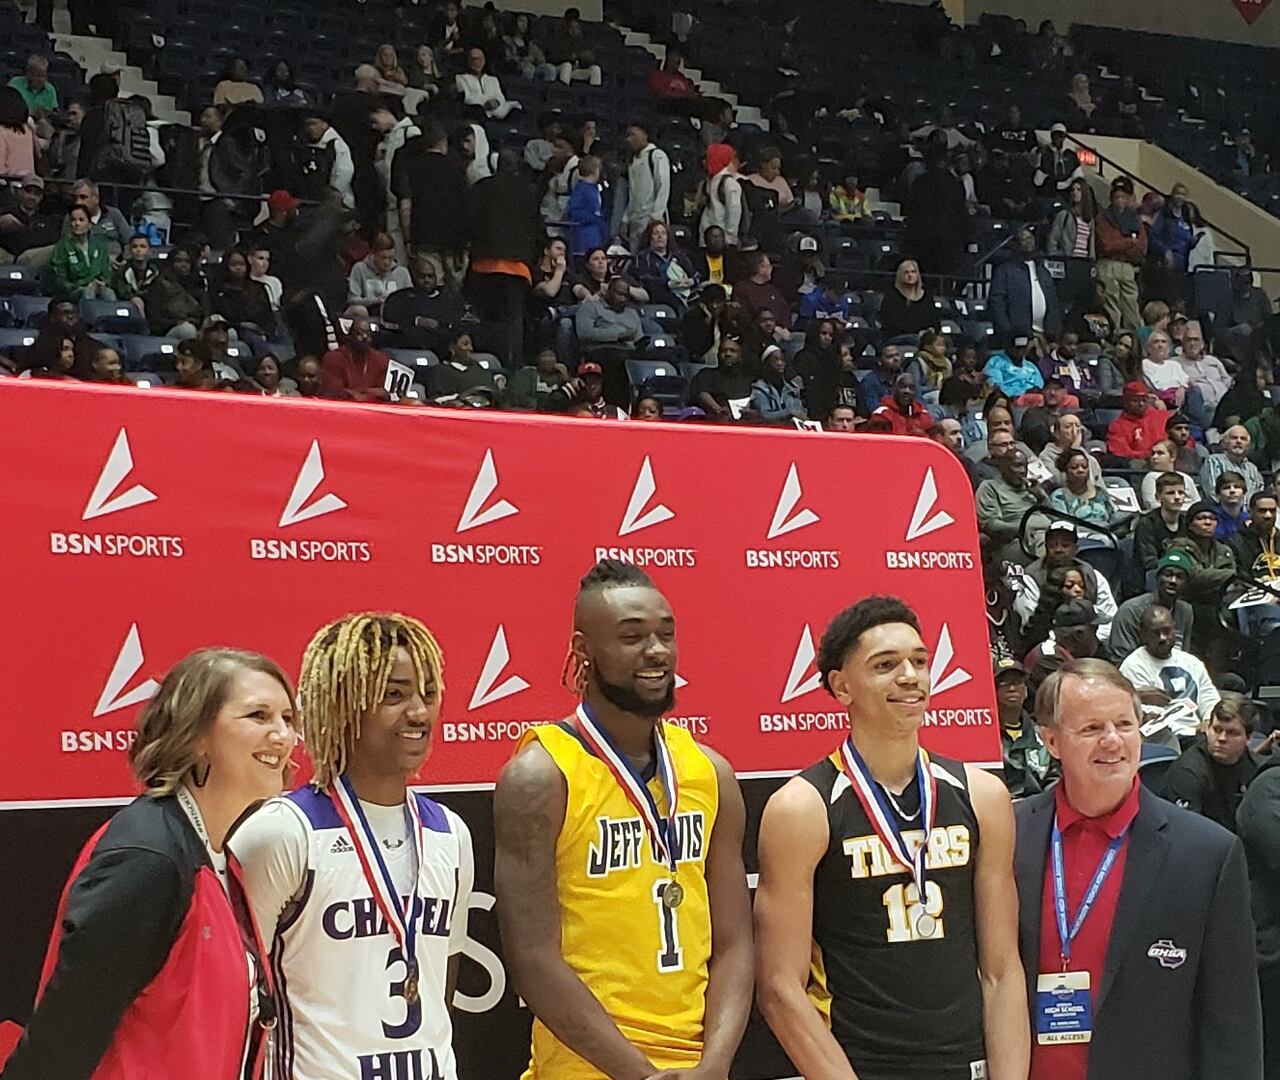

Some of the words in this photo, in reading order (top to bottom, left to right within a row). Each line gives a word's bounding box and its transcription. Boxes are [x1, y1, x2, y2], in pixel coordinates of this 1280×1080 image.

[588, 817, 642, 877] JEFF
[652, 878, 684, 973] 1
[882, 880, 945, 942] 12
[380, 947, 421, 1039] 3
